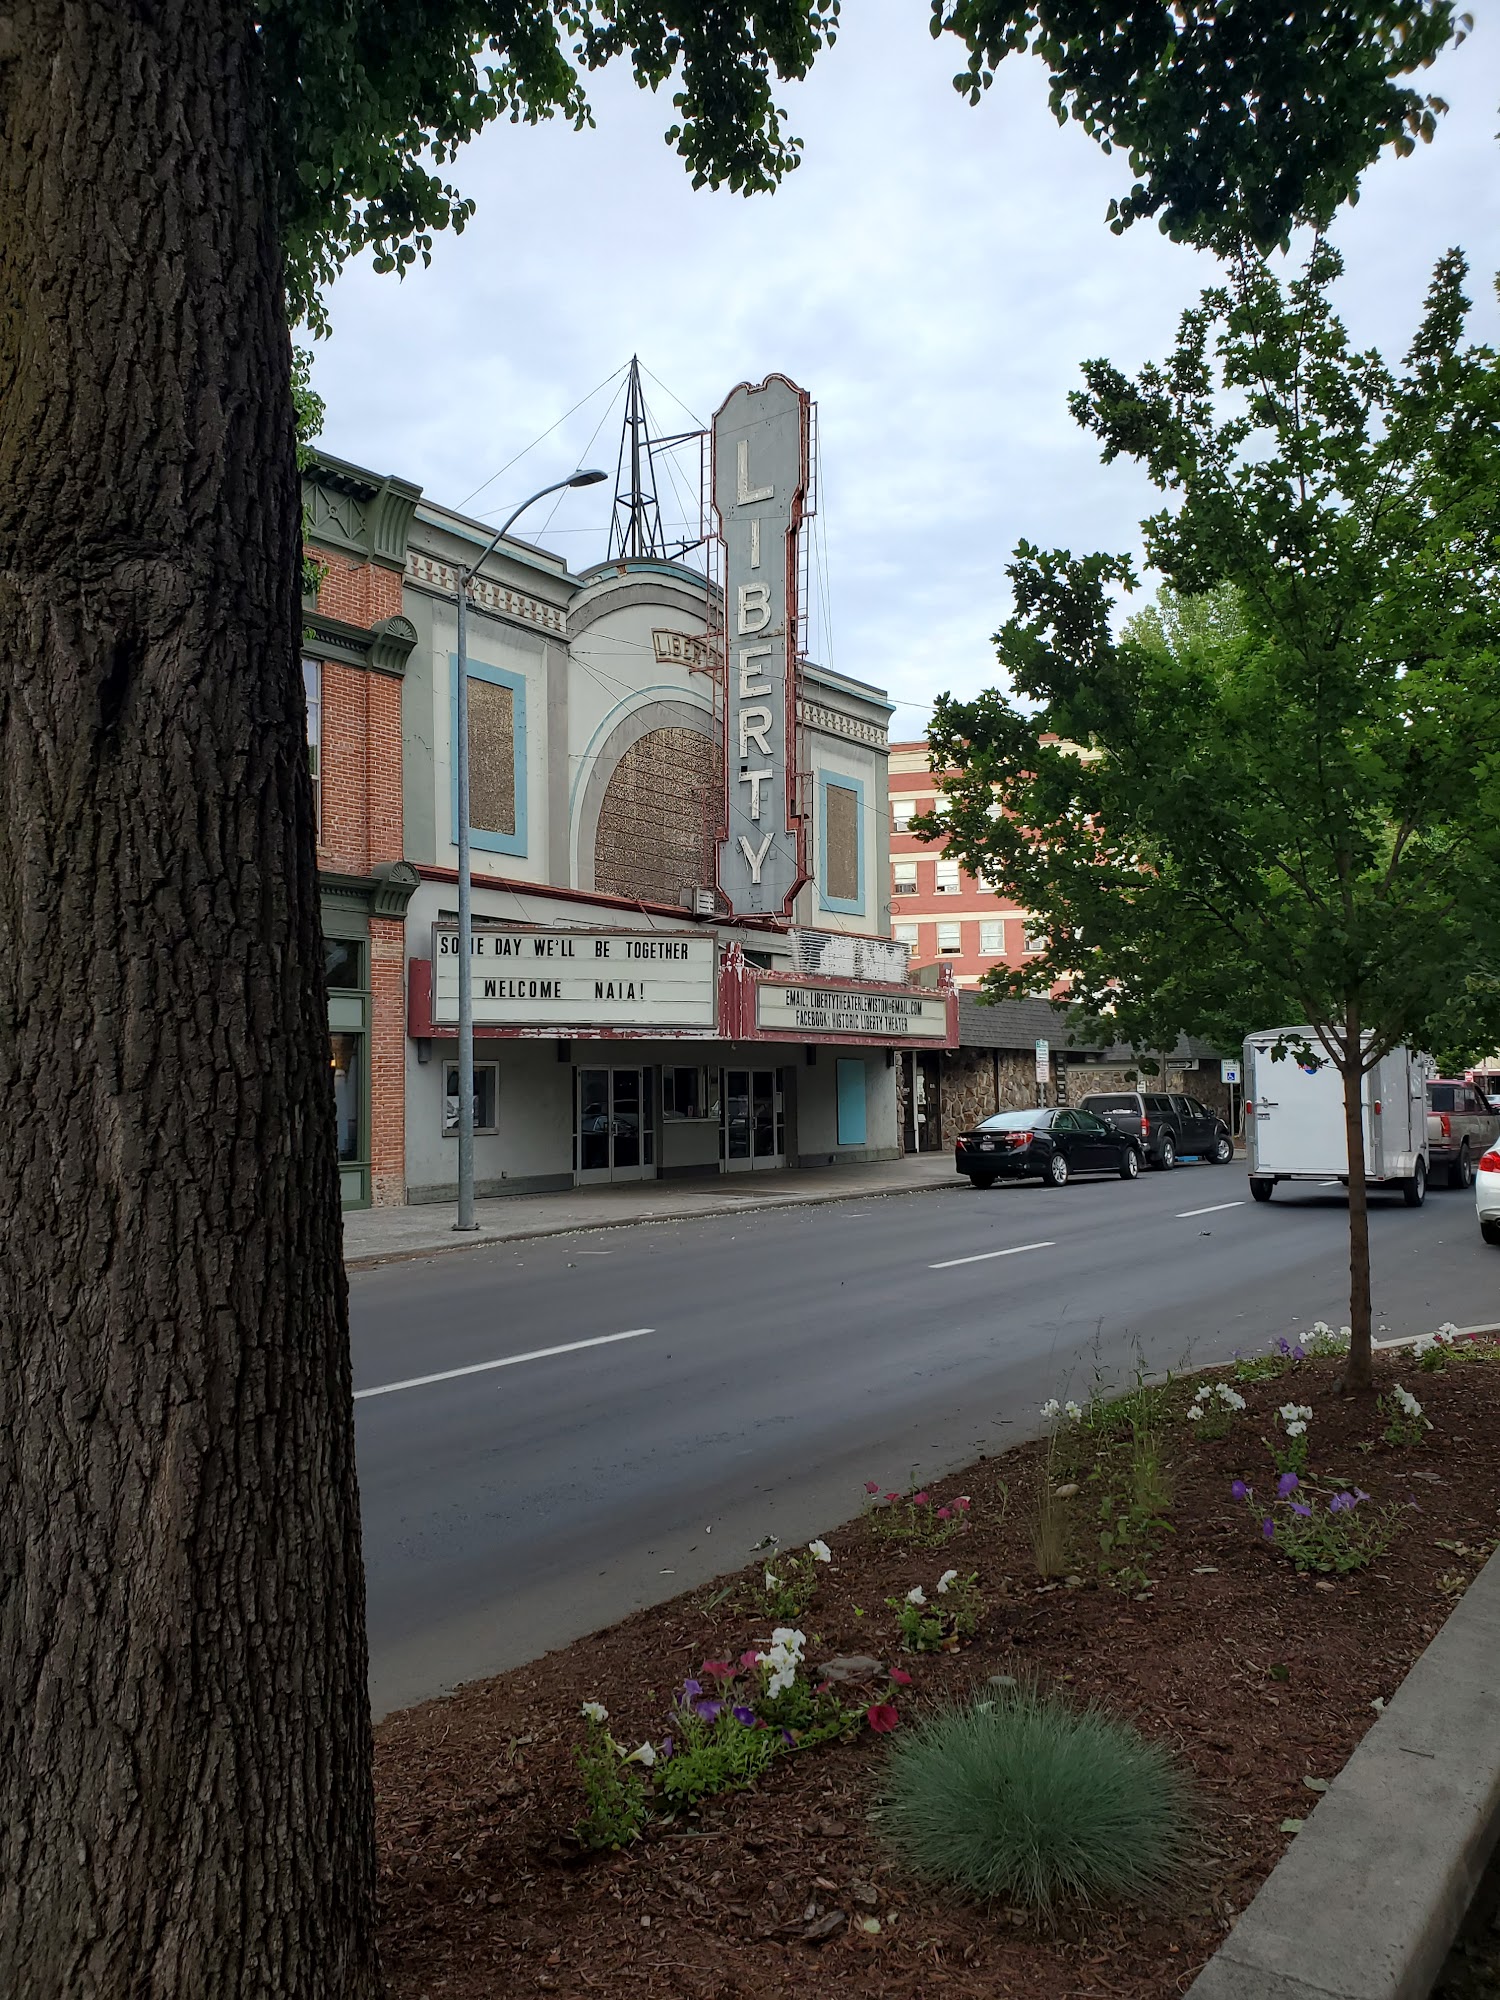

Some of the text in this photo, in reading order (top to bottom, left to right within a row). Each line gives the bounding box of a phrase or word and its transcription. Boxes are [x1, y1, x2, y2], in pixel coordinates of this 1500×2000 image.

[737, 438, 775, 884] LIBERTY
[440, 936, 689, 960] SOE DAY WE'LL BE TOGETHER
[484, 980, 645, 1000] WELCOME NAIA!
[786, 990, 809, 1007] EMAIL:
[796, 1010, 908, 1032] FACEBOOK: HISTORIC LIBERTY THEATER
